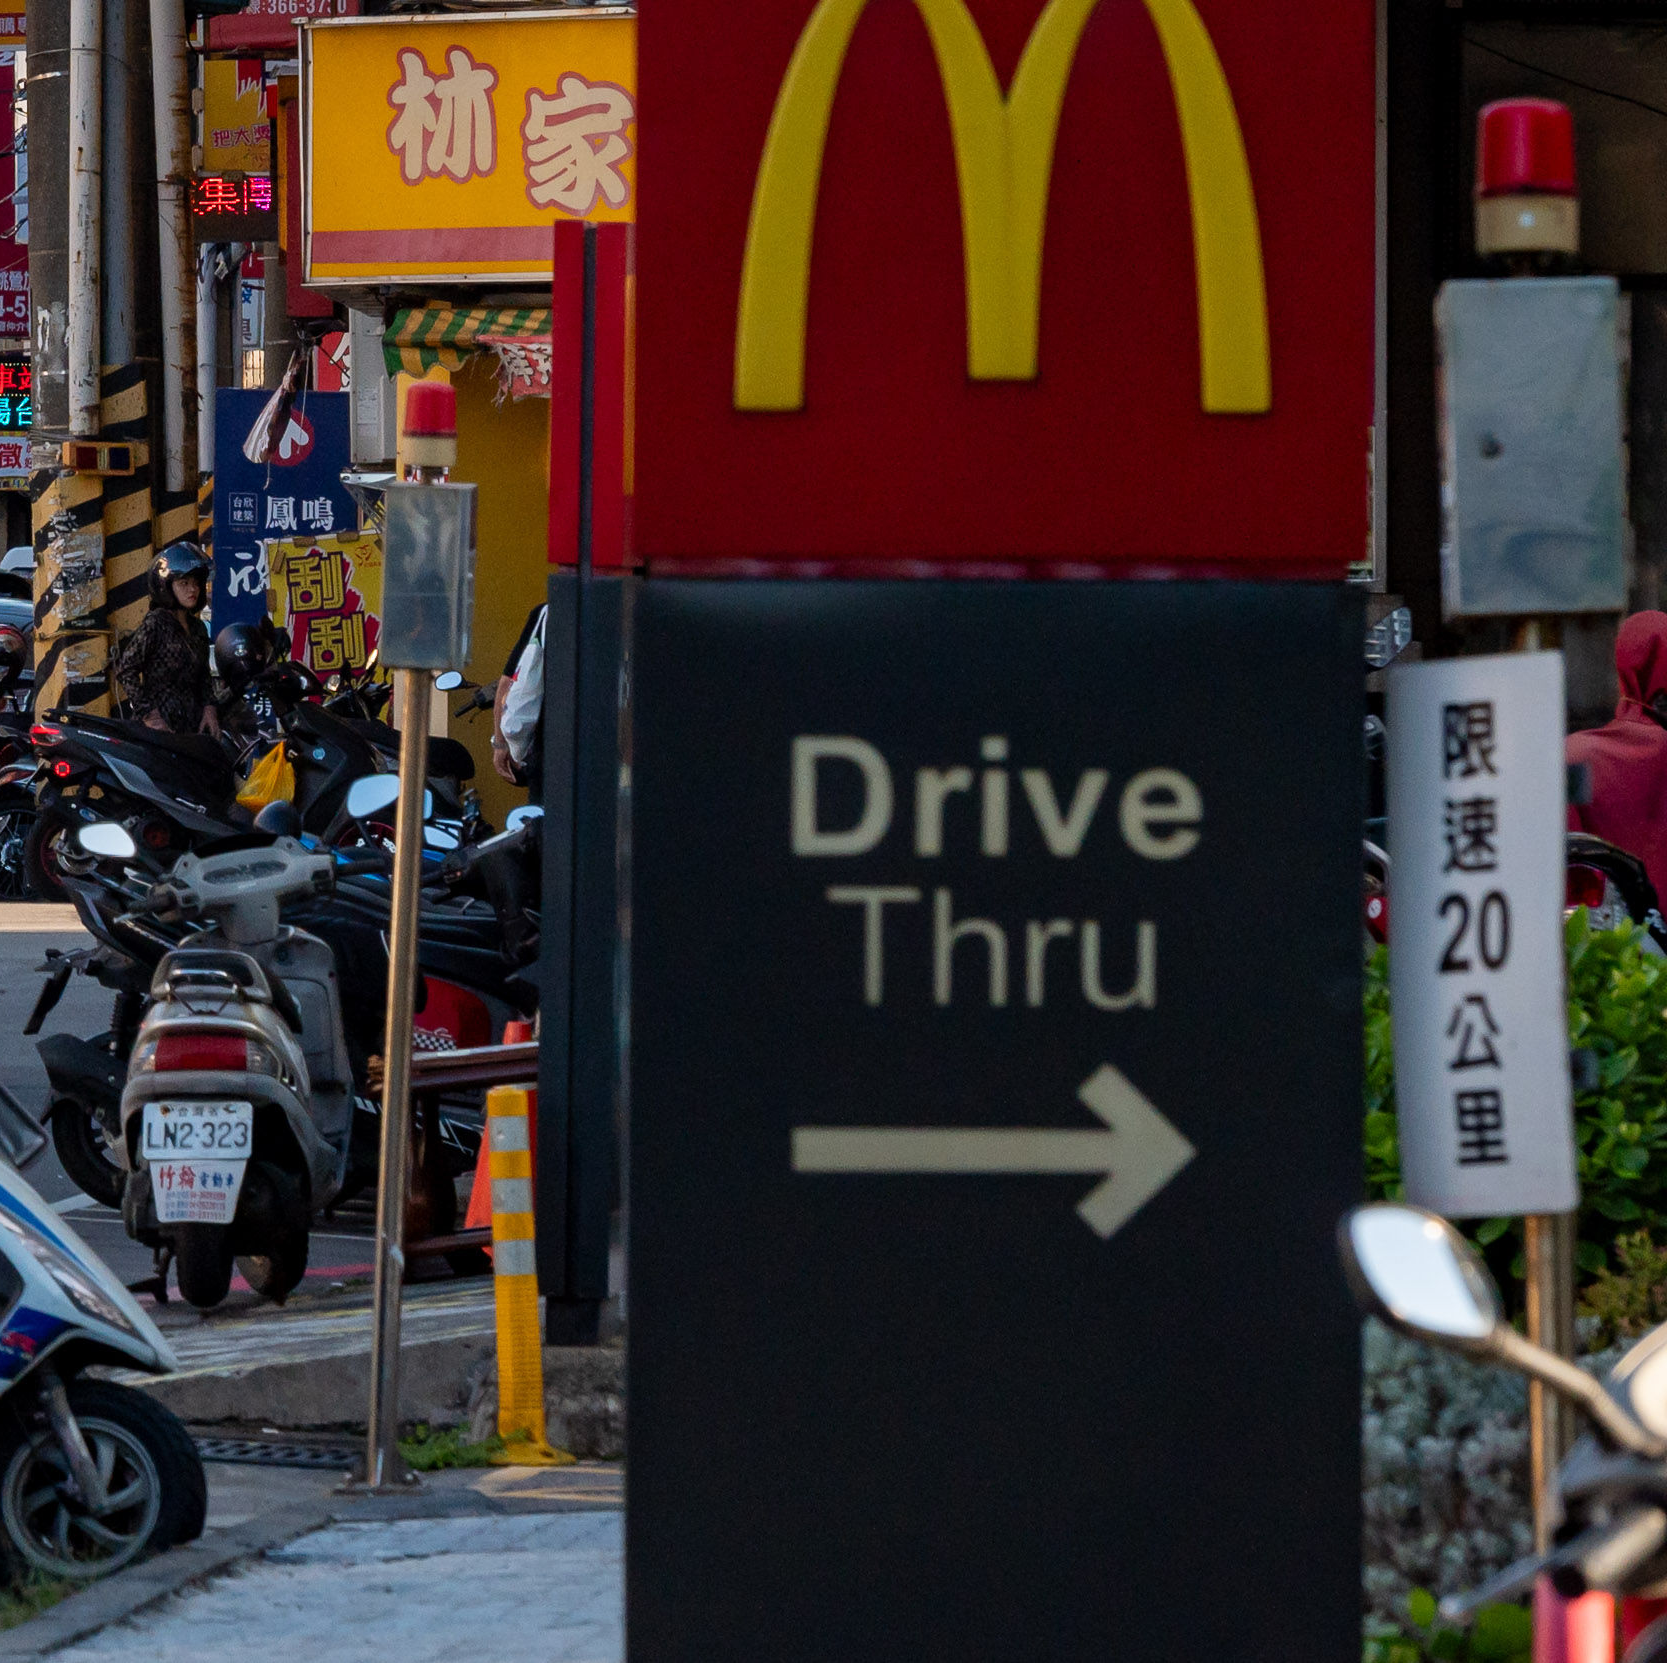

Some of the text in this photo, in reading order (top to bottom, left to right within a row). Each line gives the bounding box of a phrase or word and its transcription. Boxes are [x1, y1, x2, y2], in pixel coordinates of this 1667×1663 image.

[386, 45, 634, 215] 林家
[233, 497, 255, 509] 台欣
[265, 495, 335, 531] 鳳鳴
[790, 734, 1206, 860] Drive
[825, 884, 1159, 1011] Thru
[1436, 699, 1513, 1169] 限速20公里
[146, 1122, 249, 1149] LN2-323
